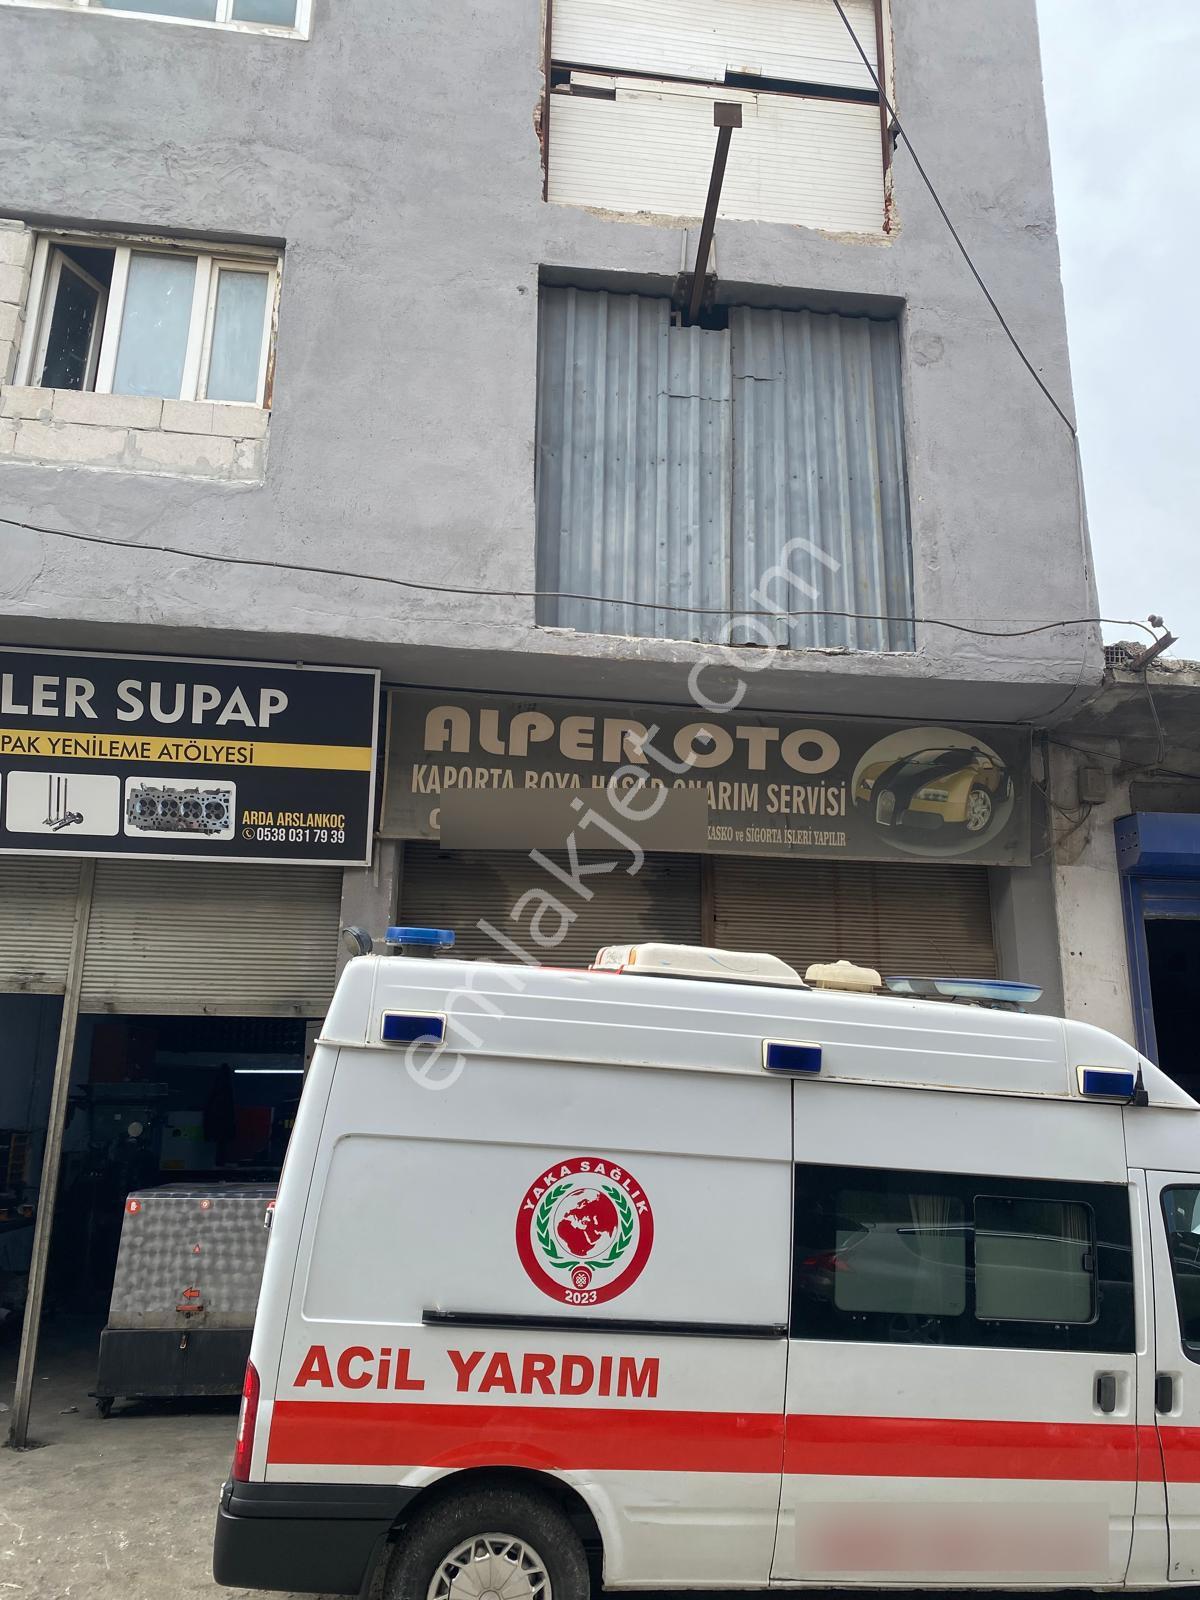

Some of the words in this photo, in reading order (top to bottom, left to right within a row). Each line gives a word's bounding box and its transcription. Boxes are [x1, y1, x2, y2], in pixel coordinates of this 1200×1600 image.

[2, 673, 98, 718] LER
[116, 679, 288, 728] SUPAP
[1, 735, 40, 753] PAK
[48, 735, 151, 759] YENİLEME
[158, 740, 255, 764] ATÖLYESİ
[424, 705, 649, 764] ALPER
[673, 723, 841, 774] OTO
[766, 780, 846, 816] SERVİSİ
[242, 811, 273, 826] ARDA
[276, 812, 345, 831] ARSLANKOÇ
[256, 828, 286, 842] 0538
[289, 829, 310, 843] 031
[312, 829, 328, 843] 79
[331, 829, 345, 844] 39
[735, 832, 744, 842] ve
[745, 824, 782, 844] SİGORTA
[784, 825, 812, 849] İŞLERİ
[813, 830, 846, 847] YAPILIR
[523, 1165, 571, 1211] YAKA
[580, 1161, 649, 1215] SAĞLIK
[565, 1290, 598, 1304] 2023
[446, 1350, 660, 1398] YARDIM
